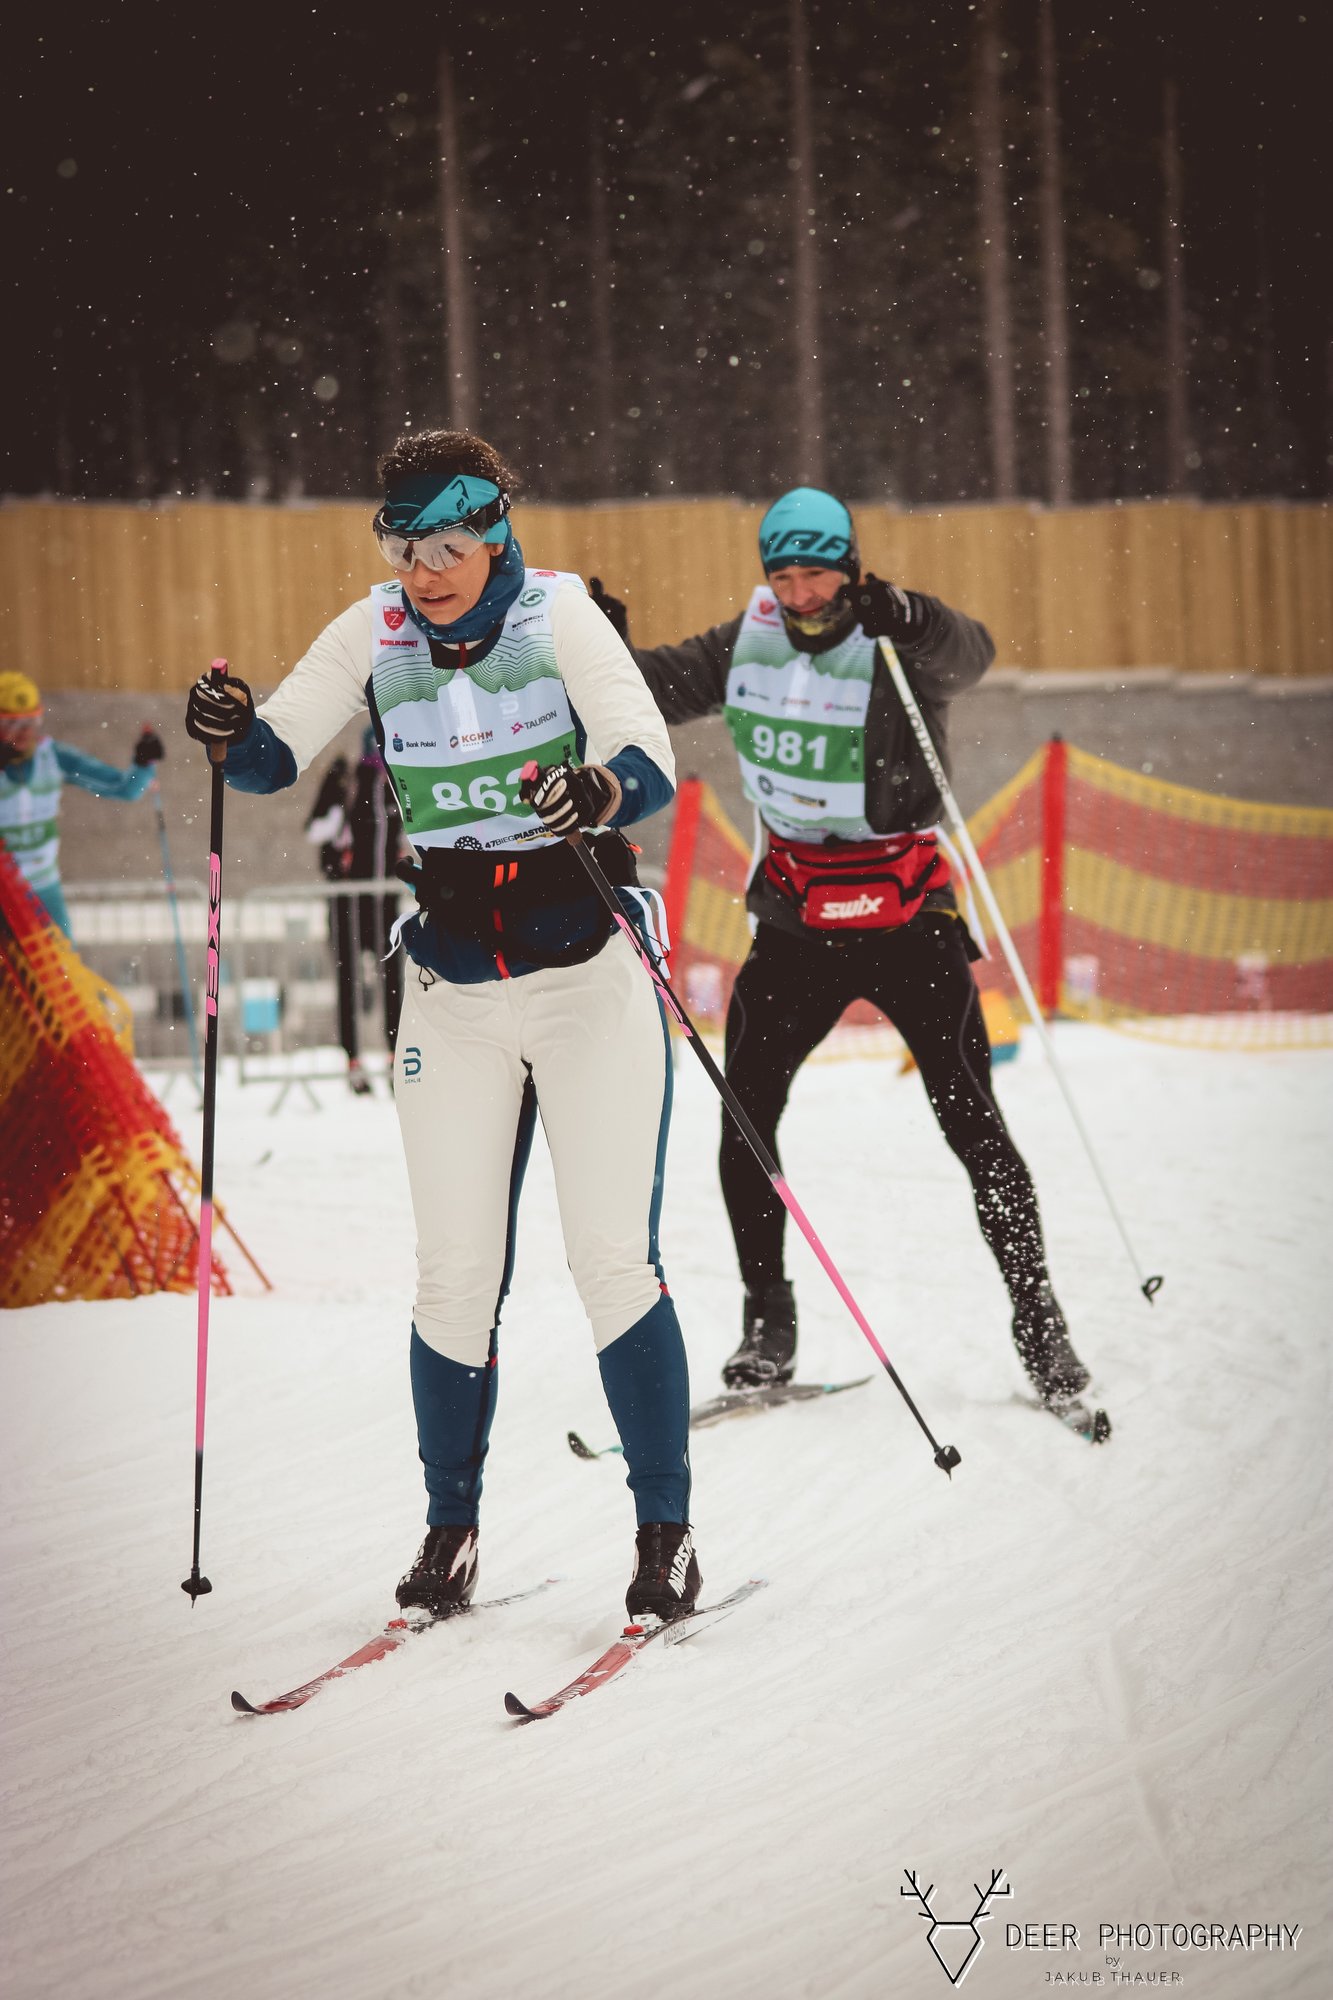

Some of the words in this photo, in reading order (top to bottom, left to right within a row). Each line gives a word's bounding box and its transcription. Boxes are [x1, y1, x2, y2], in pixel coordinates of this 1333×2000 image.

[379, 638, 419, 648] WORLDLOPPET
[524, 709, 558, 730] TAURON
[461, 730, 493, 743] KGHM
[752, 724, 828, 770] 981
[820, 893, 884, 920] swix
